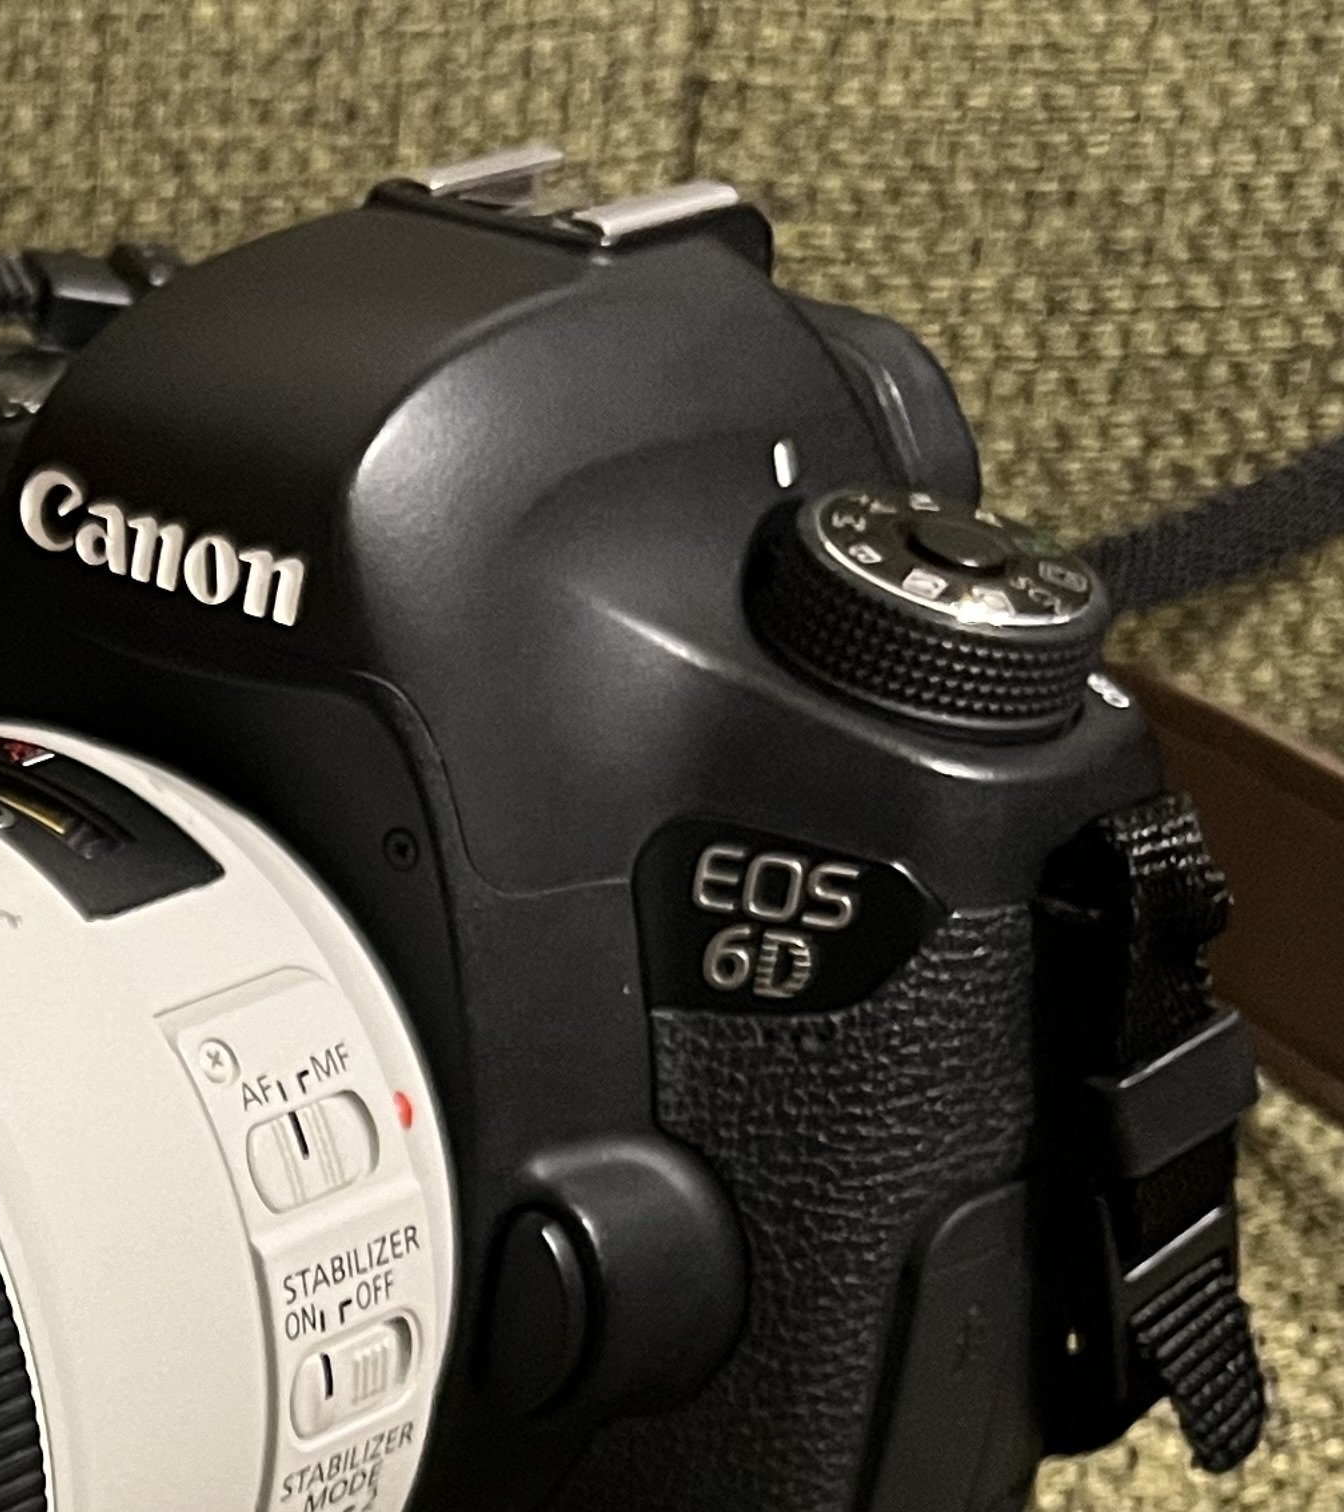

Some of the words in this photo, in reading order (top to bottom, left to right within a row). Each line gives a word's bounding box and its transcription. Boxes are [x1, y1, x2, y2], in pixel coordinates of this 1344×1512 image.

[20, 469, 305, 627] Canon
[692, 844, 860, 931] EOS
[702, 924, 812, 998] 6D
[241, 1074, 272, 1112] AF
[308, 1041, 351, 1083] MF
[282, 1224, 421, 1306] STABILIZER
[284, 1303, 317, 1341] ON
[355, 1269, 395, 1311] OFF
[280, 1420, 415, 1503] STABILIZER
